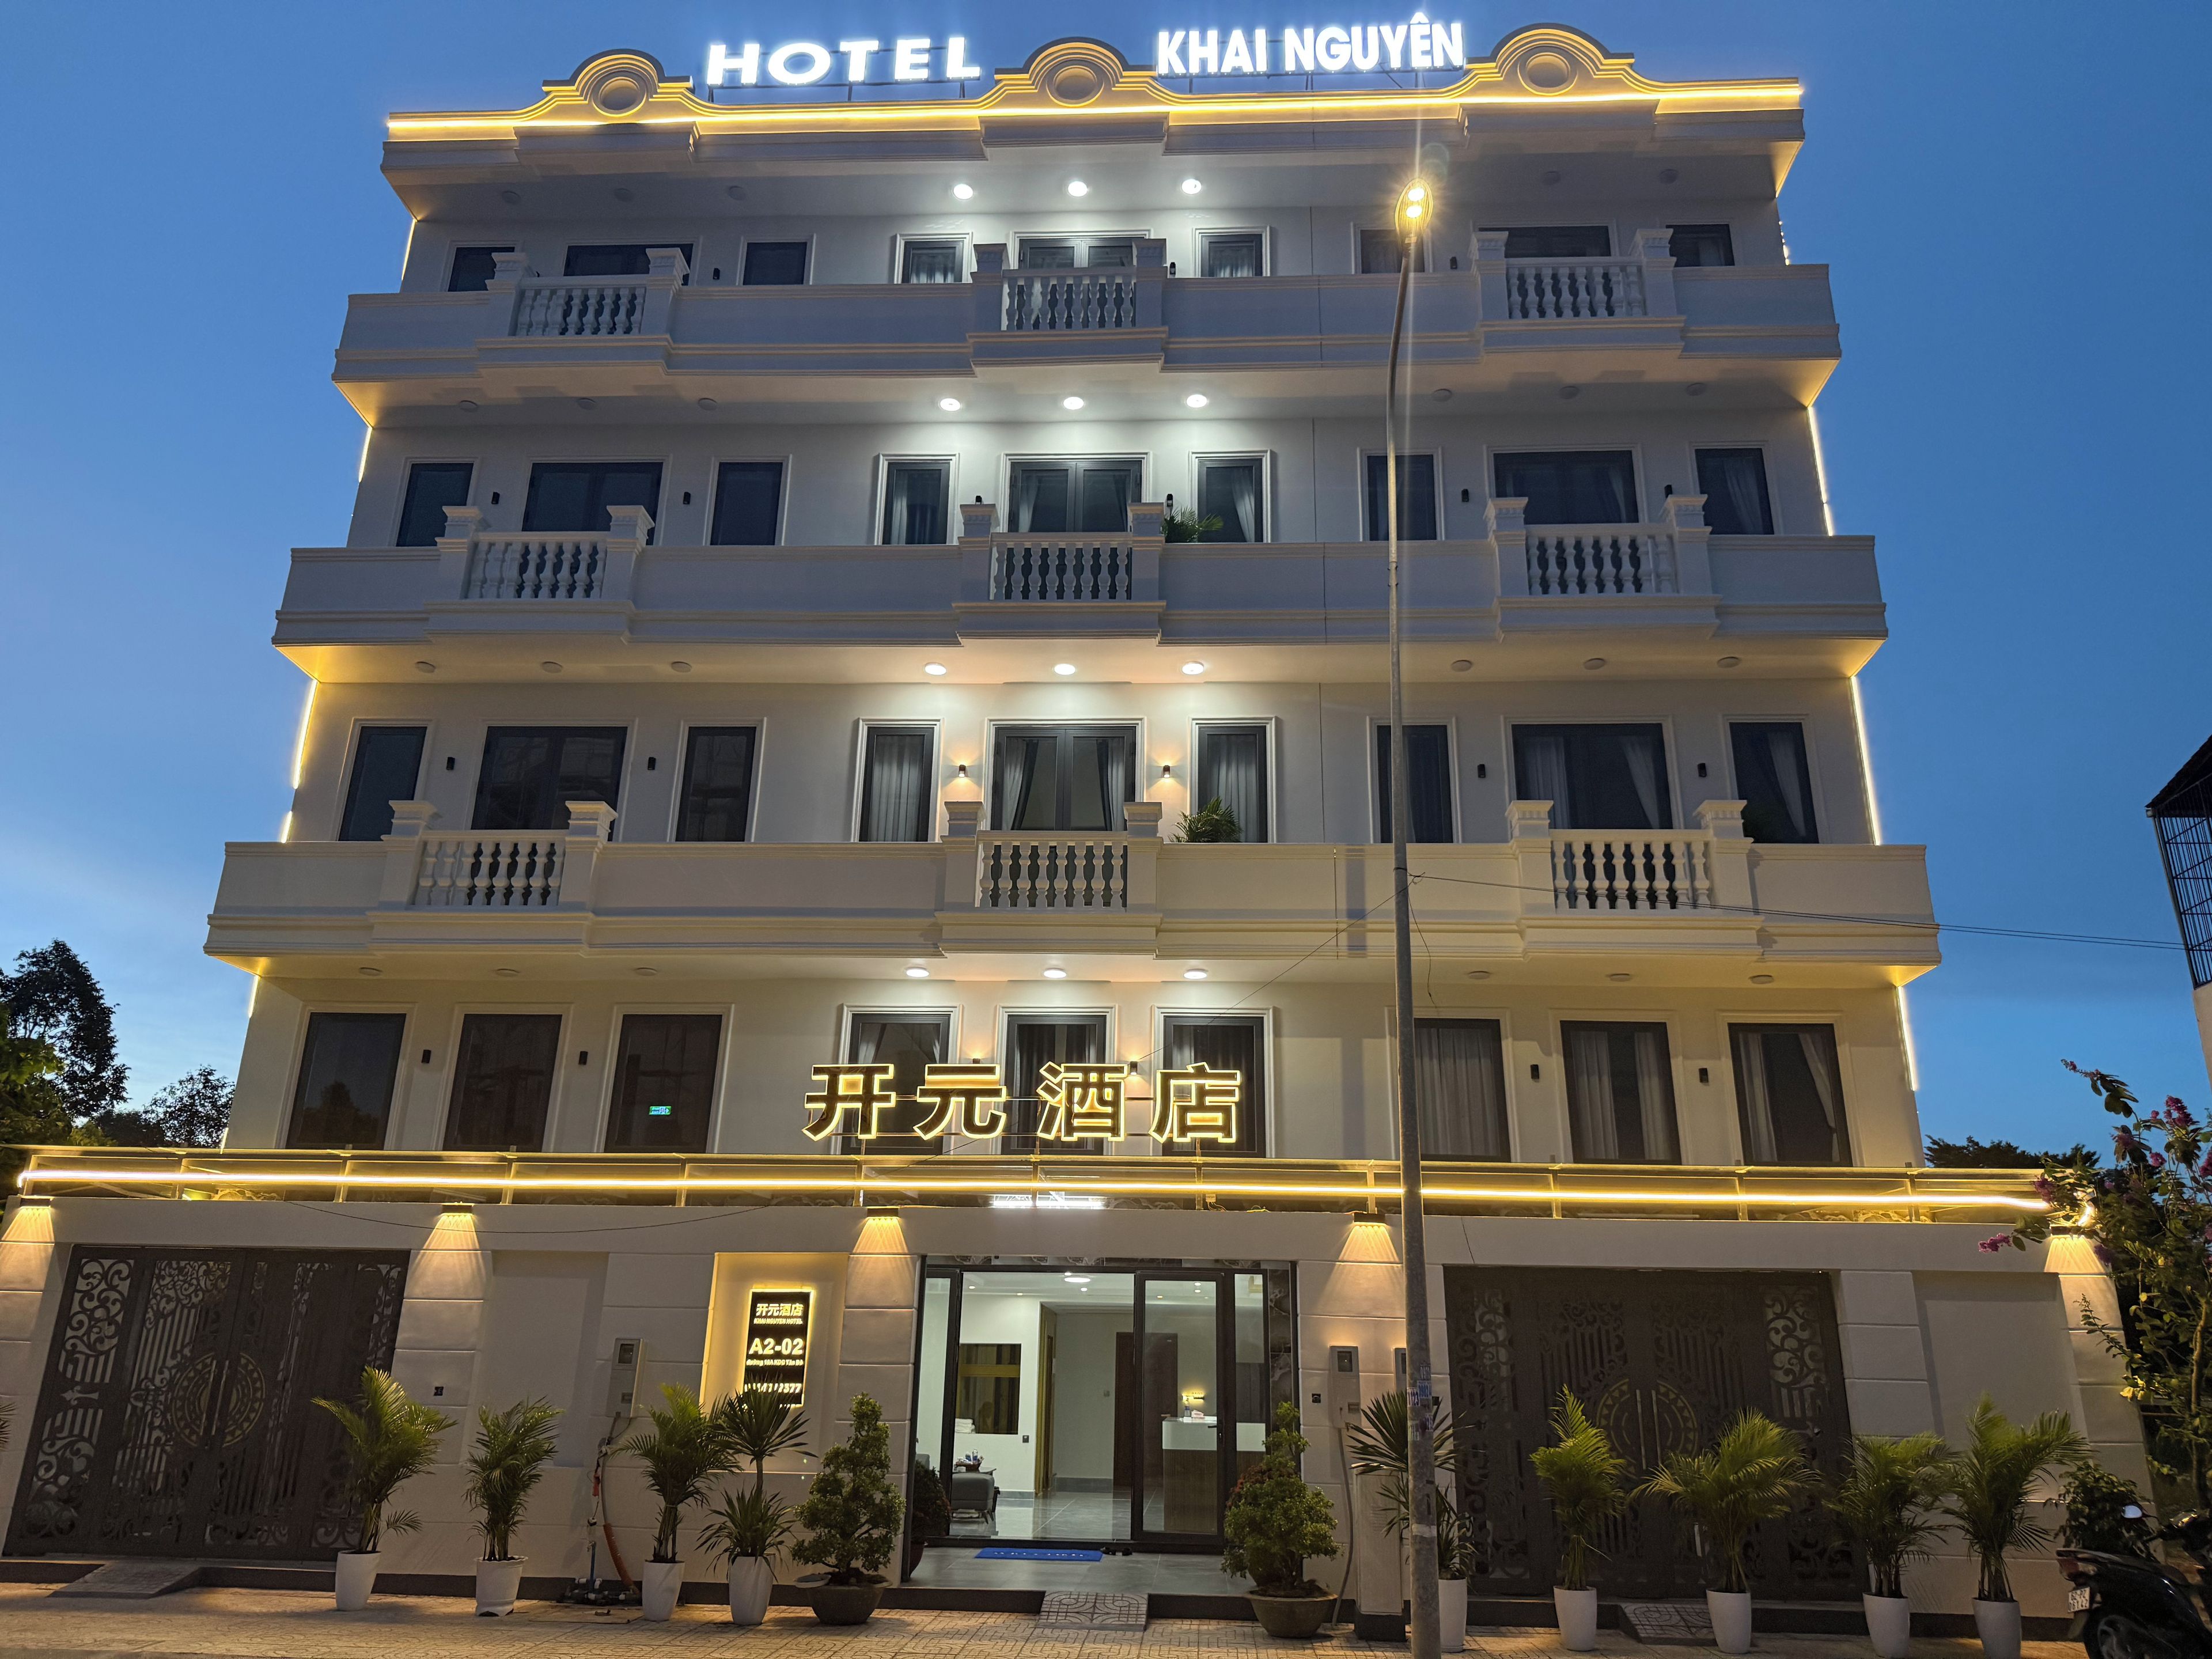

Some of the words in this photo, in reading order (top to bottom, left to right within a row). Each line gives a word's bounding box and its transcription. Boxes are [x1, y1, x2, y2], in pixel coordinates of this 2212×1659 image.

[706, 36, 981, 86] HOTEL
[1158, 28, 1267, 75] KHAI
[1284, 12, 1464, 73] NGUYÊN
[802, 1061, 1240, 1143] 开元酒店
[756, 1303, 804, 1316] 开元酒店
[749, 1338, 804, 1355] A2-02
